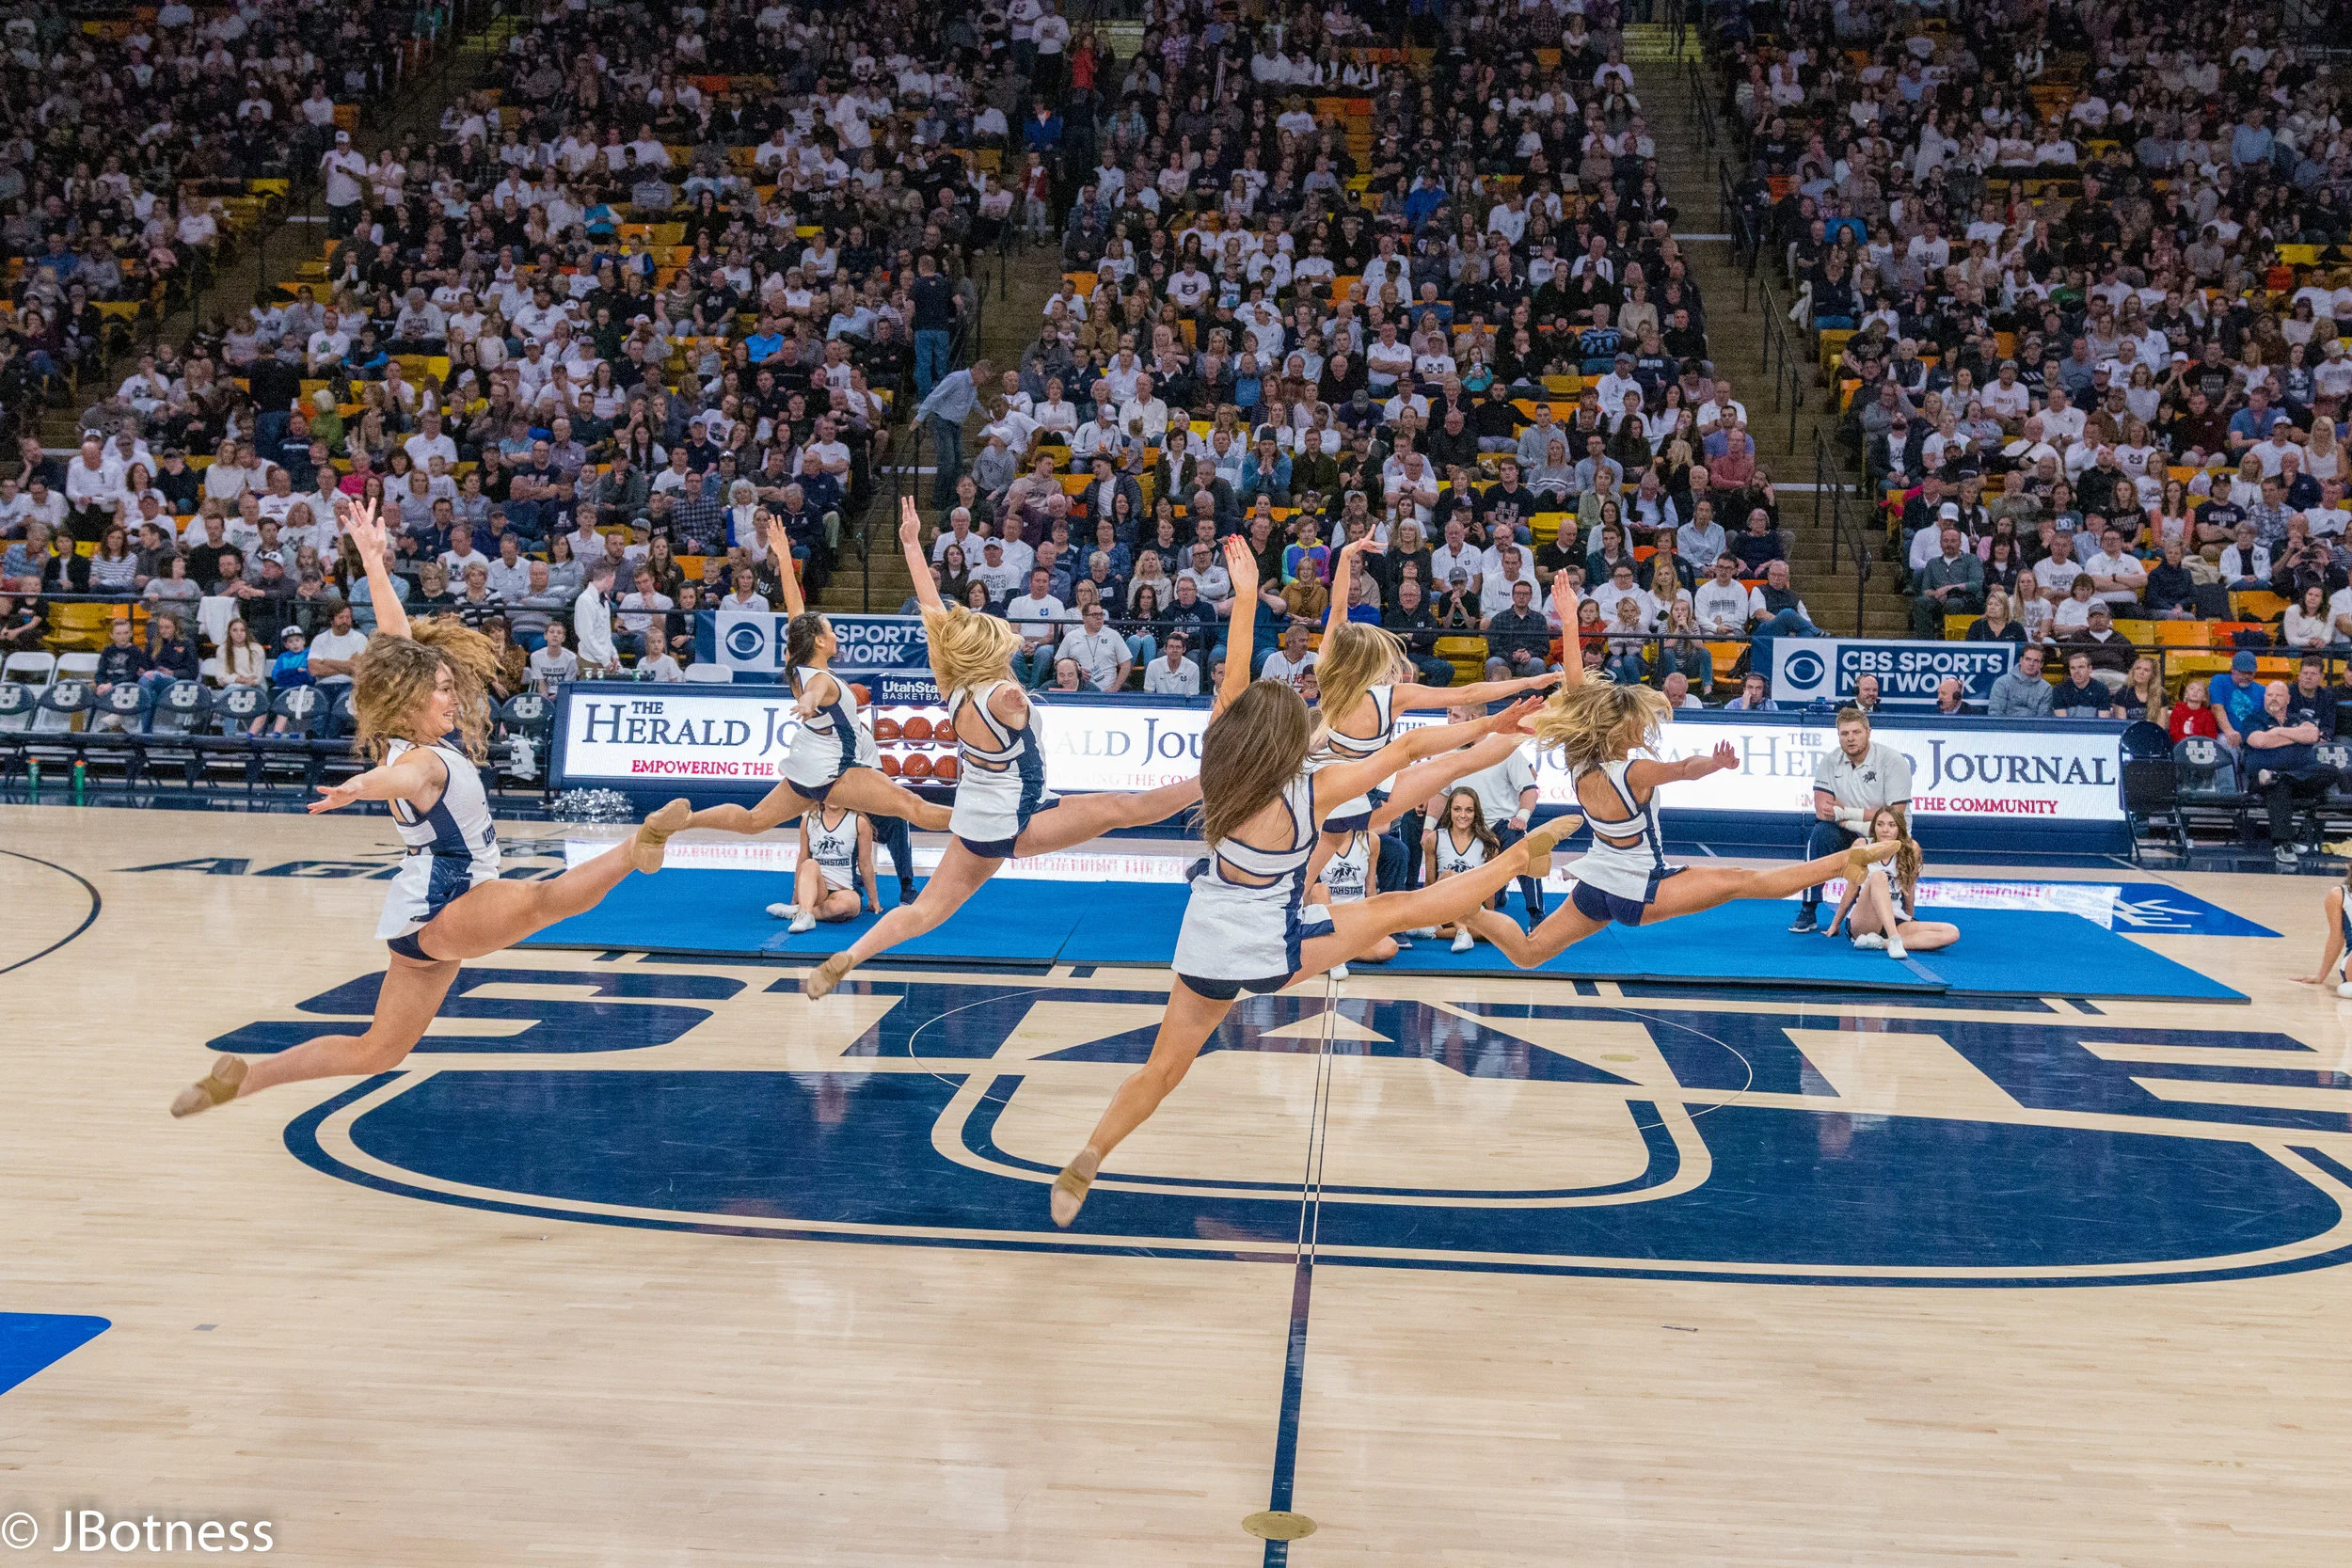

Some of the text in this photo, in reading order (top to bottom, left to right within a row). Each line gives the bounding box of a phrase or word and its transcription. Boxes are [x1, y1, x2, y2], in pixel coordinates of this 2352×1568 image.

[834, 624, 928, 643] SPORTS
[1841, 651, 2003, 673] CBS SPORTS
[1841, 672, 1977, 693] NTWOK
[631, 701, 663, 714] THE
[581, 703, 751, 746] HERALD
[1788, 732, 1821, 746] THE
[631, 759, 739, 776] EMPOWERING
[742, 762, 773, 776] THE
[1927, 739, 2116, 791] JOURNAL
[1913, 797, 2058, 815] THE COMMUNITY
